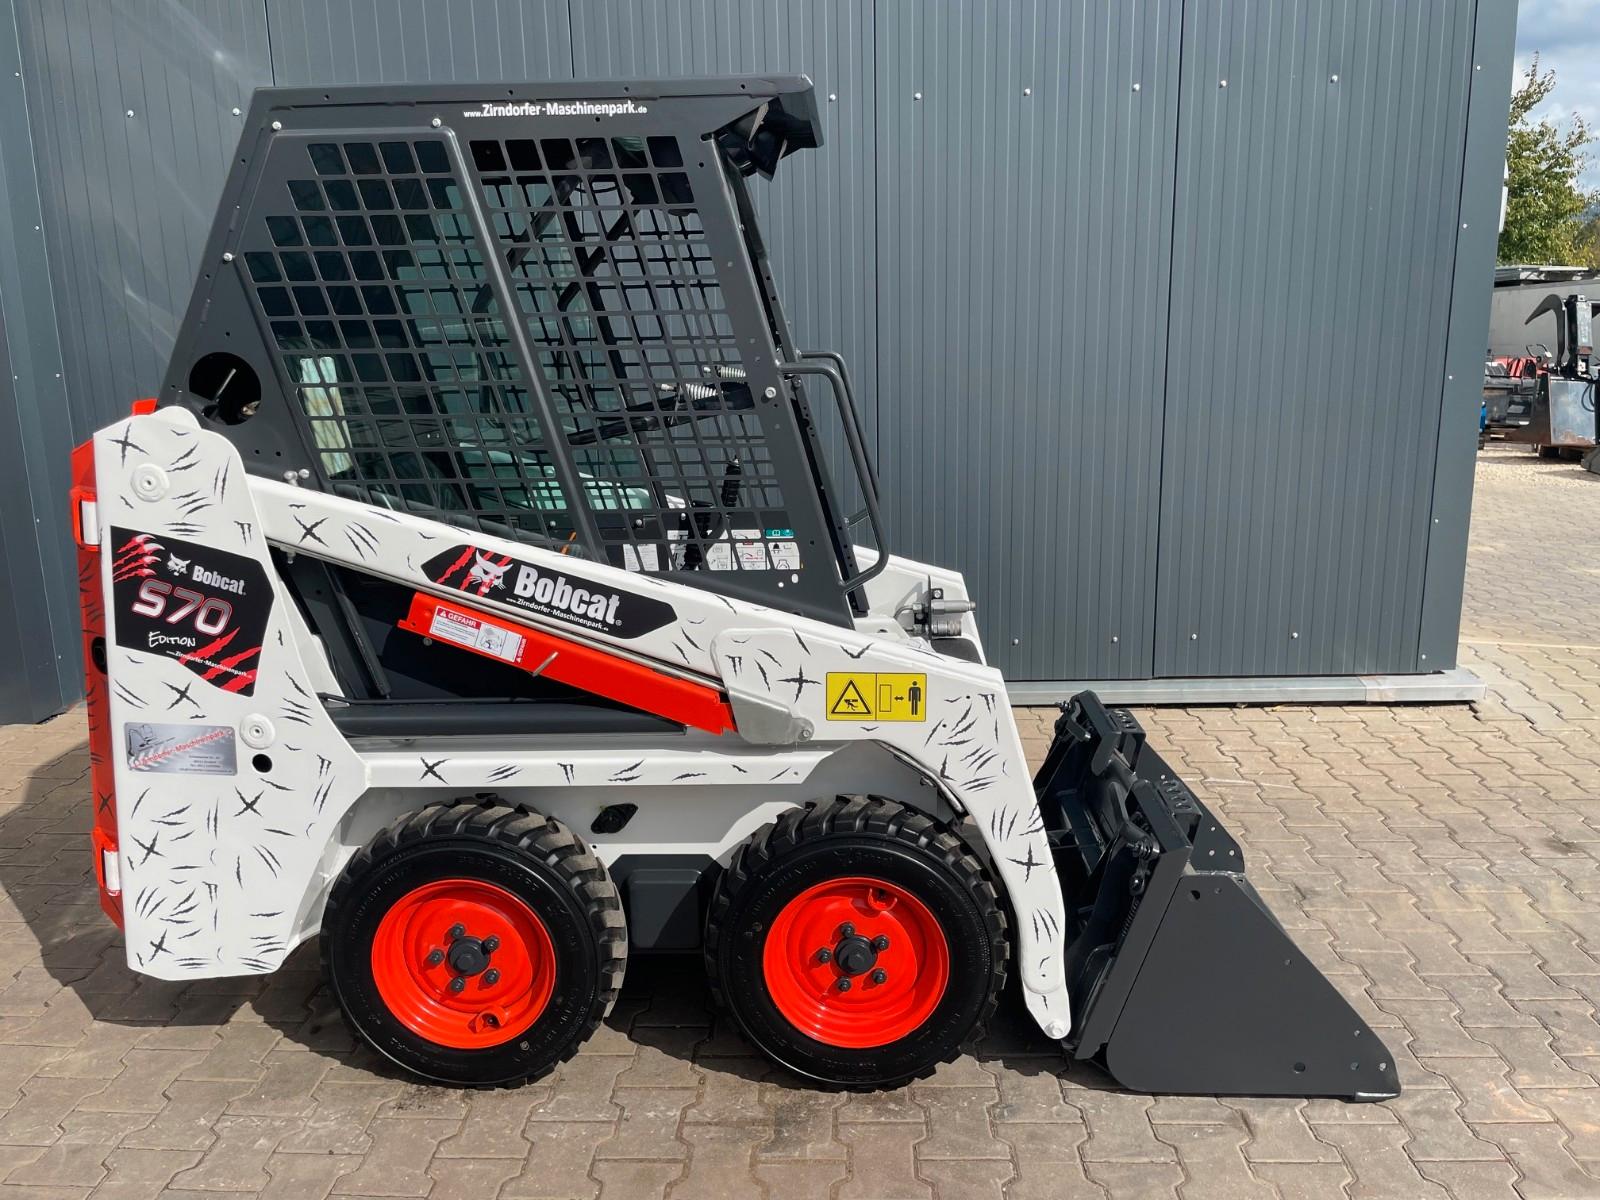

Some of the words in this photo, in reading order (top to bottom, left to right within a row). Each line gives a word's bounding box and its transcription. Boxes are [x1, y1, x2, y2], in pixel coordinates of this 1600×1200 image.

[463, 100, 647, 118] www.Zirndorfer-Maschinenpark.de
[192, 565, 246, 595] Bobcat
[513, 564, 620, 626] Bobcat
[131, 578, 233, 636] S70
[447, 612, 477, 628] GEFAHR
